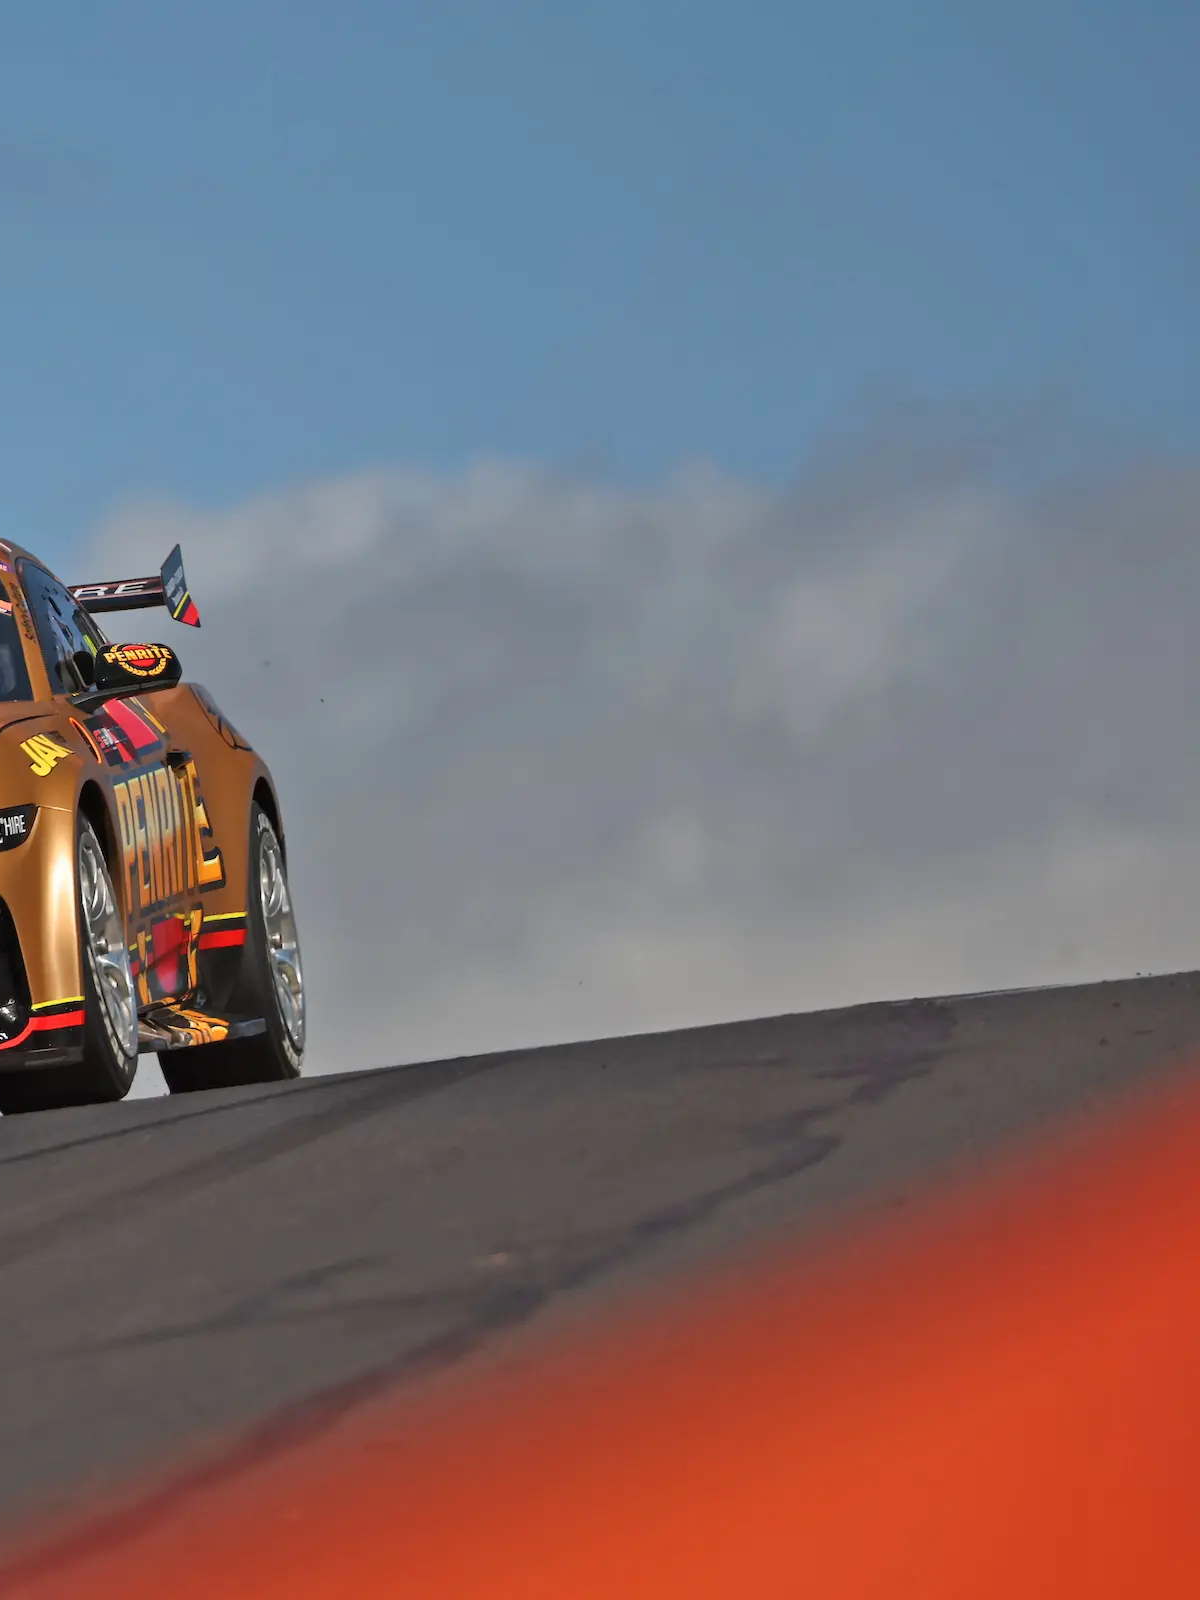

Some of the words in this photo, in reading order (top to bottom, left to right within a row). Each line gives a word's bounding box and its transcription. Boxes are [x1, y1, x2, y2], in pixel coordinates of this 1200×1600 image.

[103, 647, 173, 664] PENRITE
[3, 815, 27, 836] HIRE
[113, 760, 223, 913] PENRITE
